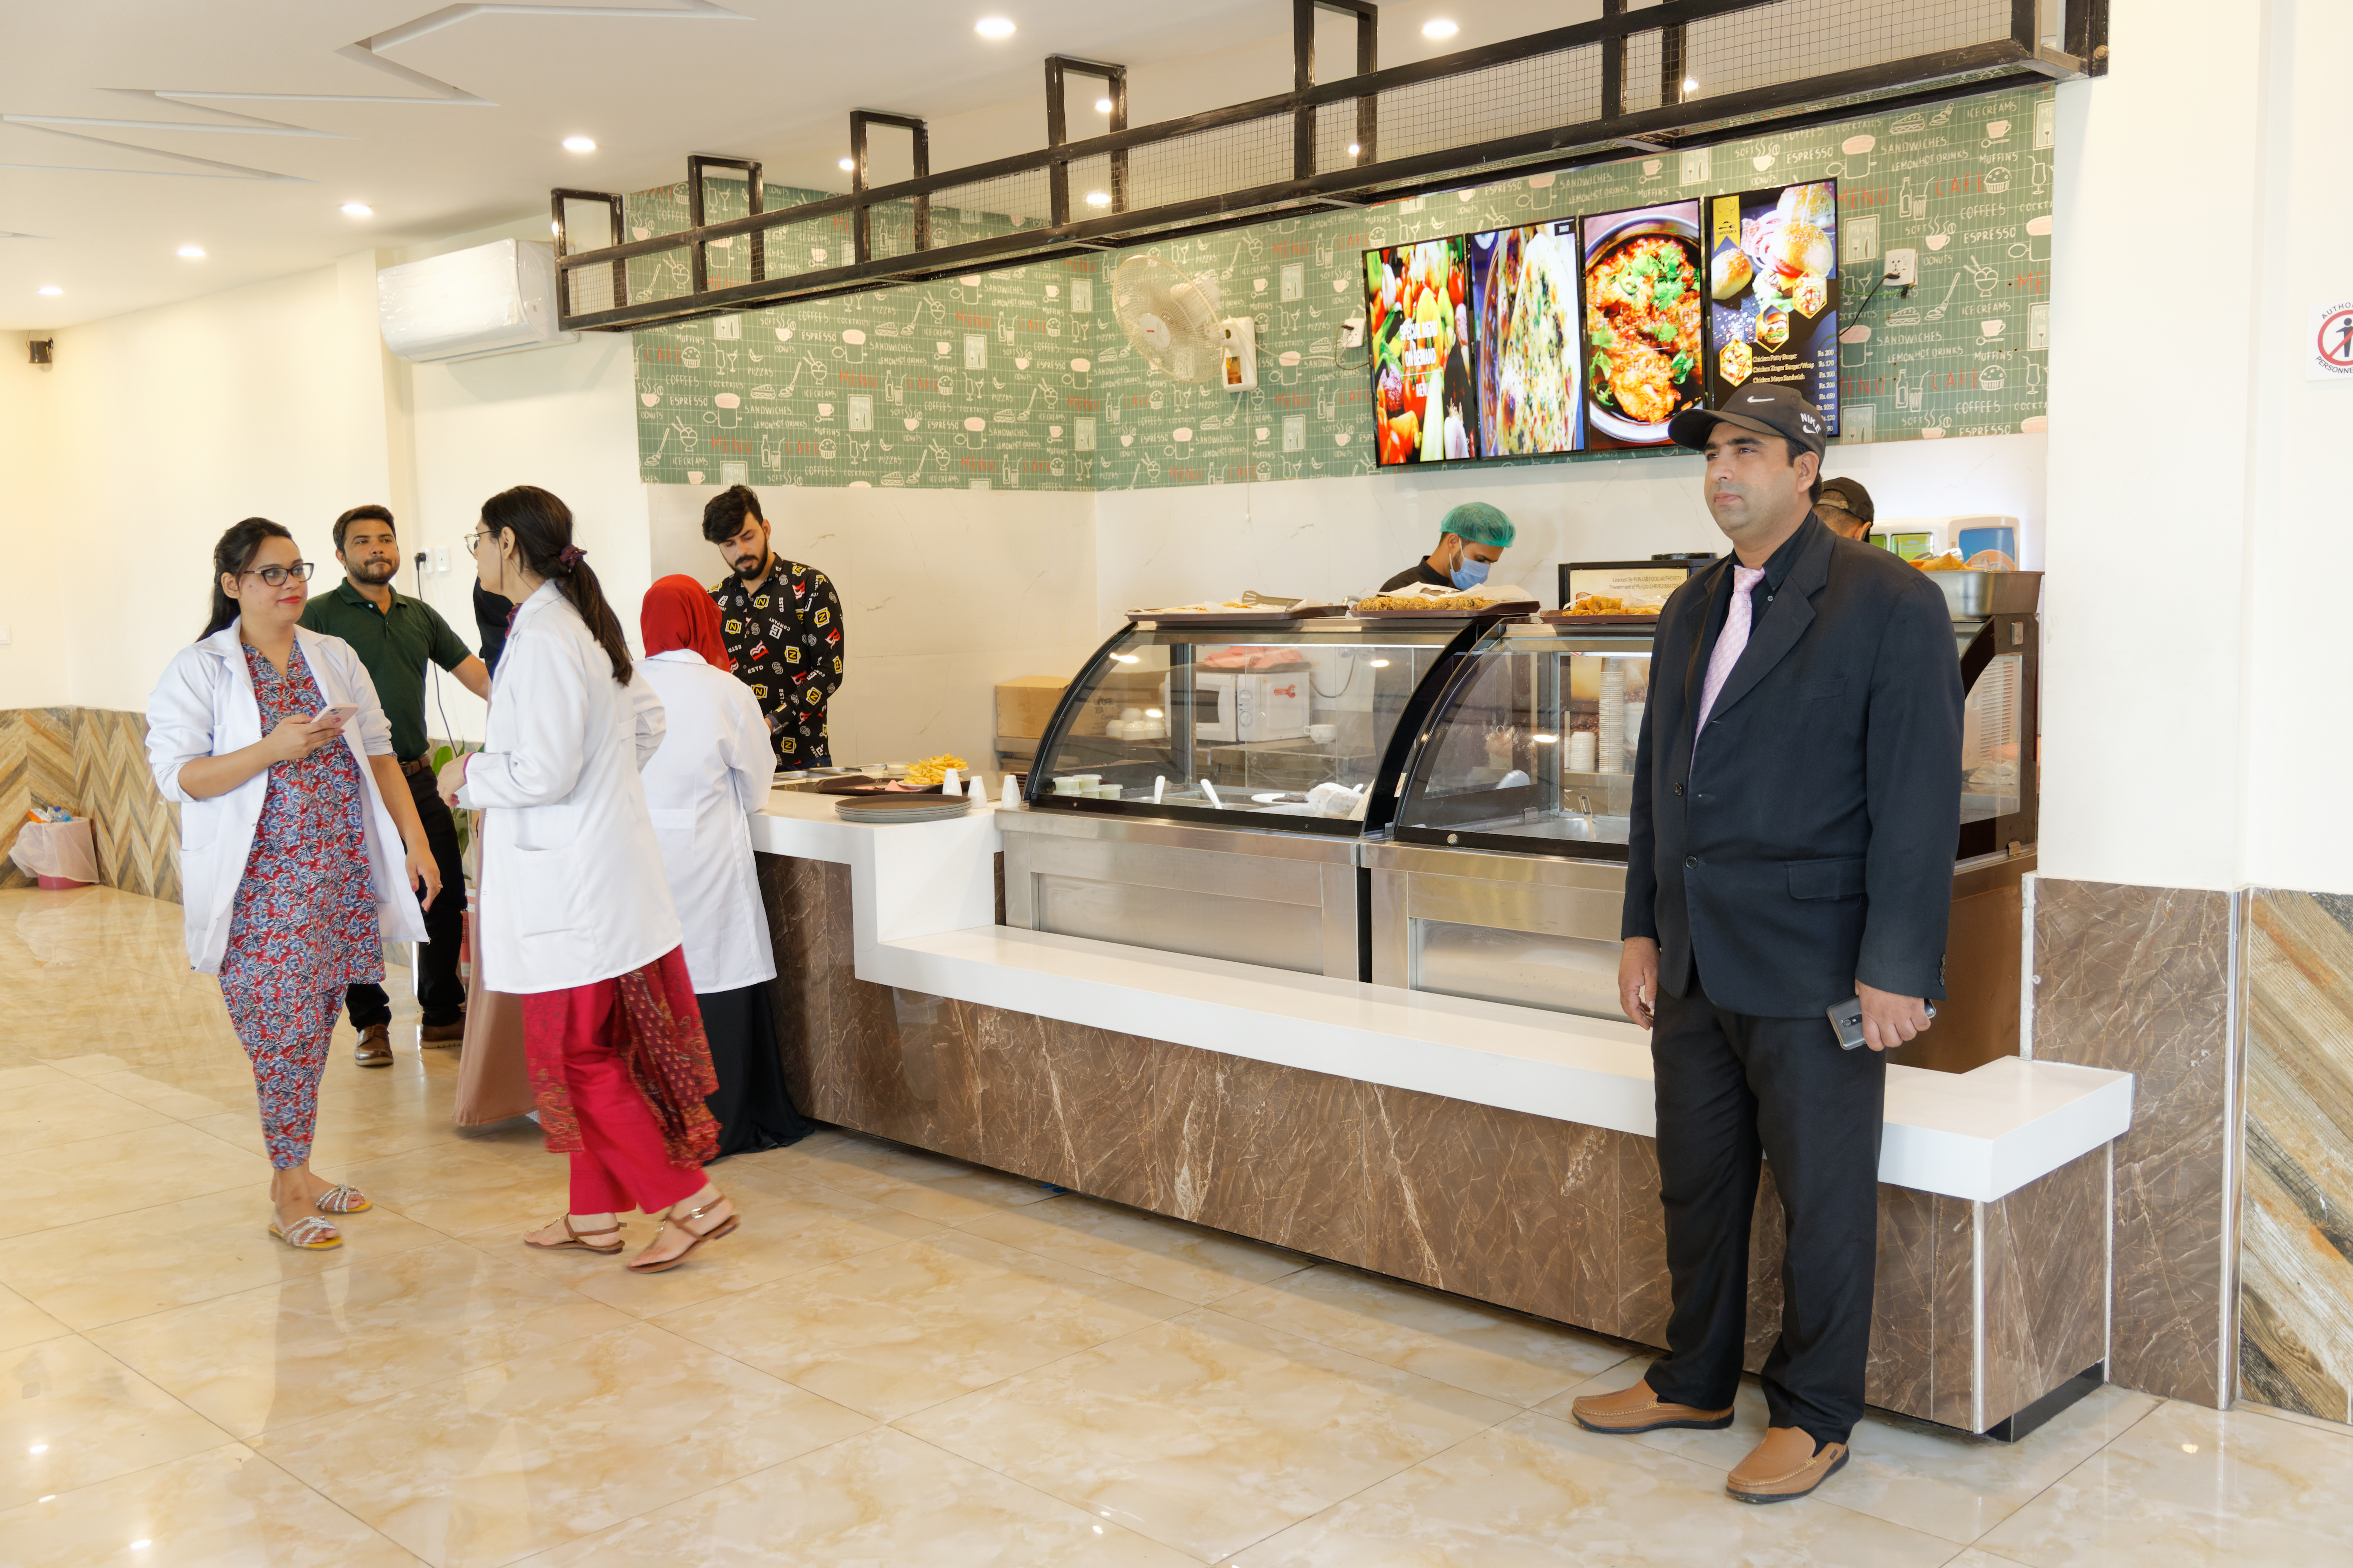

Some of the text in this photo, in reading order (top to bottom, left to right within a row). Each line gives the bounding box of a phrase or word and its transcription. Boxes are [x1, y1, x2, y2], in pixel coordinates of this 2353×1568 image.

[1967, 101, 2016, 117] ICE CREAMS
[1836, 119, 1881, 132] COCKTAILS
[1881, 137, 1947, 155] SANDWICHES
[1735, 147, 1754, 157] SOFT
[1787, 148, 1833, 163] ESPRESSO
[1979, 152, 2018, 163] MUFFINS
[1917, 150, 1968, 167] HOT DRINKS
[1892, 160, 1917, 172] LEMON
[1559, 172, 1612, 188] SANDWICHES
[1752, 175, 1777, 186] DONUTS
[1936, 173, 1984, 196] CAFE
[1485, 182, 1522, 195] ESPRESSO
[1604, 186, 1629, 196] DRINKS
[1638, 188, 1668, 197] MUFFINS
[1837, 184, 1888, 209] MENU
[1457, 205, 1477, 214] DONUTS
[1961, 203, 2006, 219] COFFEES
[1366, 215, 1390, 224] MUFFINS
[1906, 224, 1926, 235] SOFT
[1338, 231, 1370, 249] CAFE
[1964, 227, 2016, 244] ESPRESSO
[1274, 239, 1309, 258] MENU
[1924, 254, 1952, 266] DONUTS
[984, 284, 1024, 294] SANDWICHES
[872, 305, 896, 315] PIZZAS
[1043, 306, 1064, 316] MUFFINS
[1962, 302, 2011, 315] ICE CREAMS
[837, 316, 869, 326] COCKTAILS
[957, 311, 991, 329] MENU
[1019, 318, 1046, 333] CAFE
[1308, 322, 1329, 330] PIZZAS
[1400, 321, 1437, 341] SPECIAL MENU
[676, 334, 705, 344] MUFFINS
[802, 332, 836, 342] ESPRESSO
[1877, 331, 1942, 346] SANDWICHES
[775, 345, 795, 353] DONUTS
[870, 342, 913, 352] SANDWICHES
[1034, 343, 1059, 352] COFFEES
[1066, 347, 1093, 355] COCKTAILS
[1915, 346, 1963, 358] HOT DRINKS
[645, 346, 681, 364] CAFE
[1405, 348, 1436, 367] ON DEMAND
[1888, 352, 1914, 363] LEMON
[1974, 352, 2012, 362] MUFFINS
[1037, 360, 1065, 370] ESPRESSO
[1304, 357, 1346, 368] SANDWICHES
[747, 367, 773, 376] PIZZAS
[933, 365, 956, 374] MUFFINS
[1094, 366, 1129, 376] SANDWICHES
[666, 376, 699, 387] COFFEES
[709, 380, 743, 389] COCKTAILS
[839, 371, 877, 388] MENU
[908, 376, 937, 391] CAFE
[1932, 370, 1980, 390] CAFE
[814, 390, 836, 398] CREAMS
[1416, 383, 1428, 397] MENU
[670, 396, 708, 406] ESPRESSO
[1125, 393, 1150, 407] CAFE
[1275, 392, 1310, 408] MENU
[1341, 388, 1371, 404] CAFE
[924, 401, 952, 411] COFFEES
[1068, 396, 1100, 411] MENU
[1198, 401, 1219, 409] PIZZAS
[1956, 401, 2001, 414] COFFEES
[745, 405, 792, 414] SANDWICHES
[641, 411, 663, 420] DONUTS
[1902, 416, 1922, 426] SOFT
[928, 420, 959, 430] ESPRESSO
[1138, 417, 1162, 426] COFFEES
[1800, 413, 1821, 434] NIKE
[815, 427, 840, 436] MUFFINS
[989, 428, 1027, 437] SANDWICHES
[1140, 434, 1167, 443] ESPRESSO
[1195, 434, 1234, 443] SANDWICHES
[711, 436, 753, 454] MENU
[787, 441, 819, 455] CAFE
[1047, 447, 1067, 456] MUFFINS
[684, 457, 708, 466] CREAMS
[878, 456, 901, 464] PIZZAS
[961, 456, 996, 472] MENU
[805, 466, 834, 476] COFFEES
[1024, 459, 1049, 473] CAFE
[1229, 464, 1256, 479] CAFE
[1170, 466, 1202, 482] MENU
[768, 618, 791, 631] COMPANY
